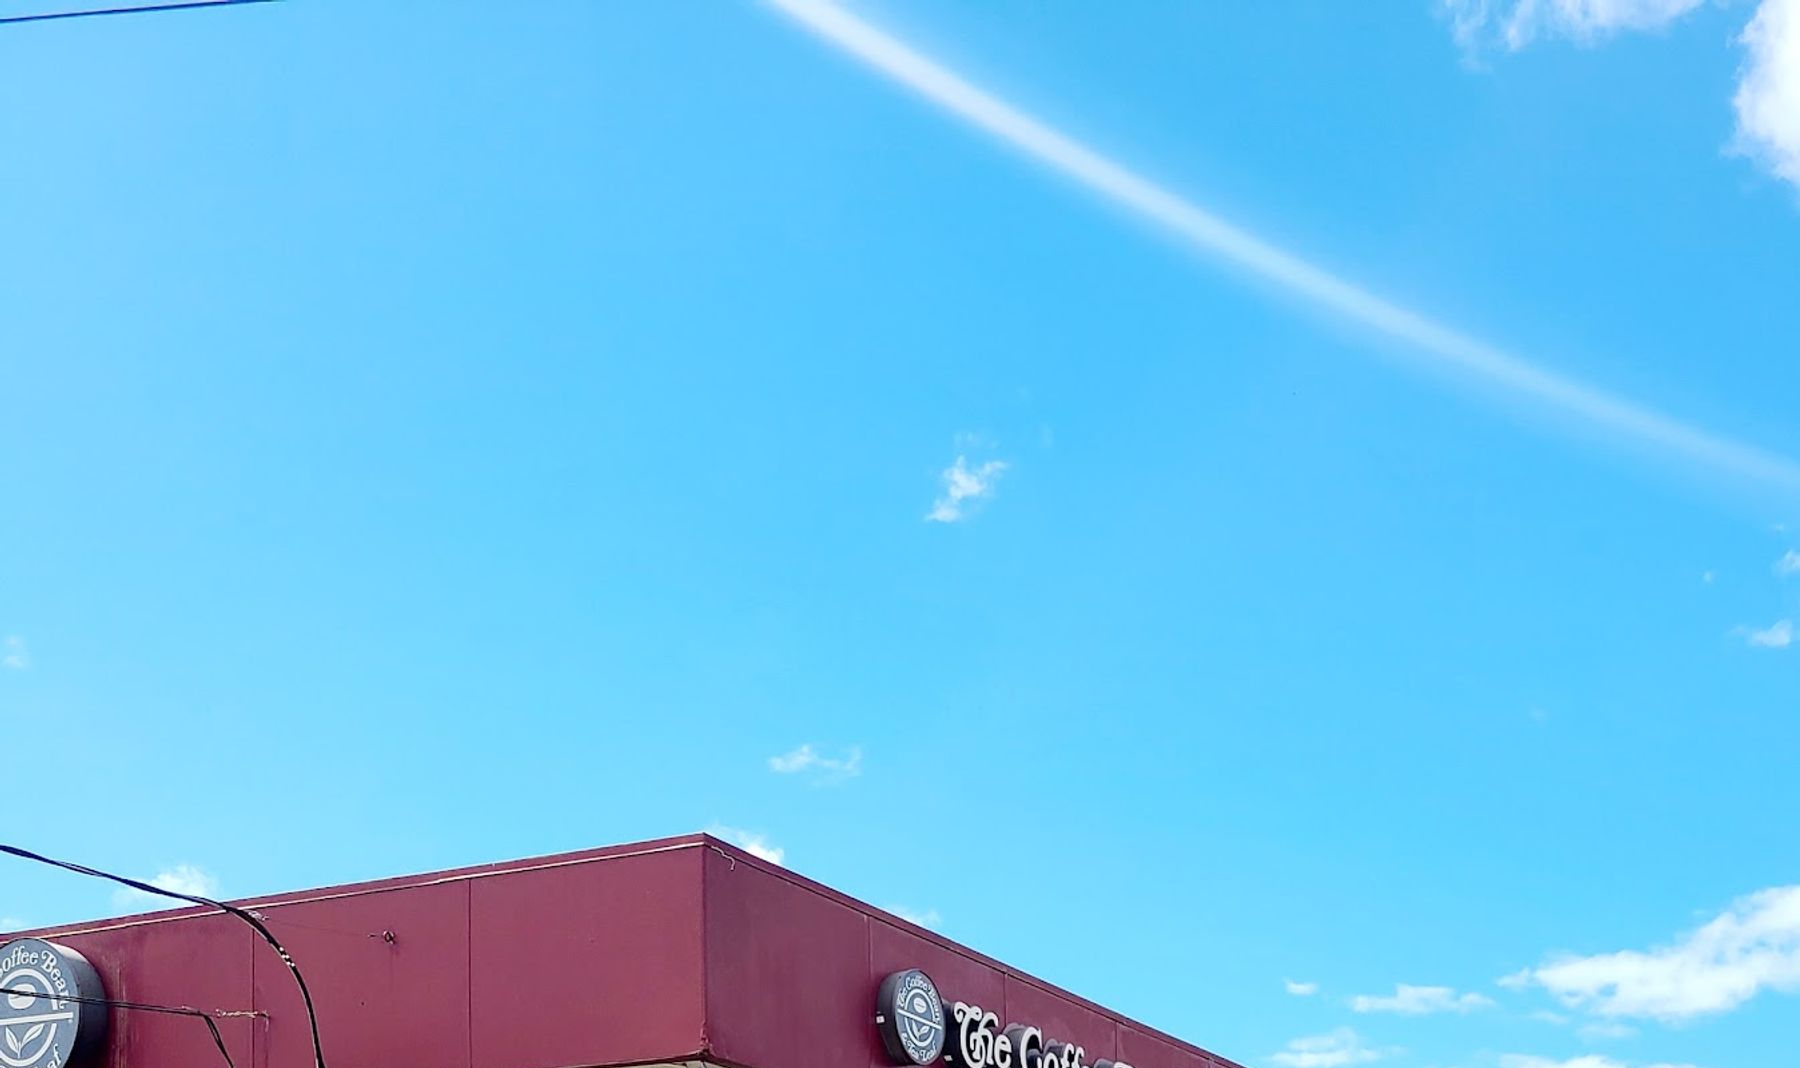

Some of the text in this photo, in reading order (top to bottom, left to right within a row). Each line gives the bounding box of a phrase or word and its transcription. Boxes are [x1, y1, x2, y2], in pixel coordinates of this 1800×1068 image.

[0, 946, 69, 1009] offee Bean
[897, 975, 940, 1023] The Coffee Bean
[907, 1041, 919, 1060] Tea
[920, 1040, 937, 1062] Leaf
